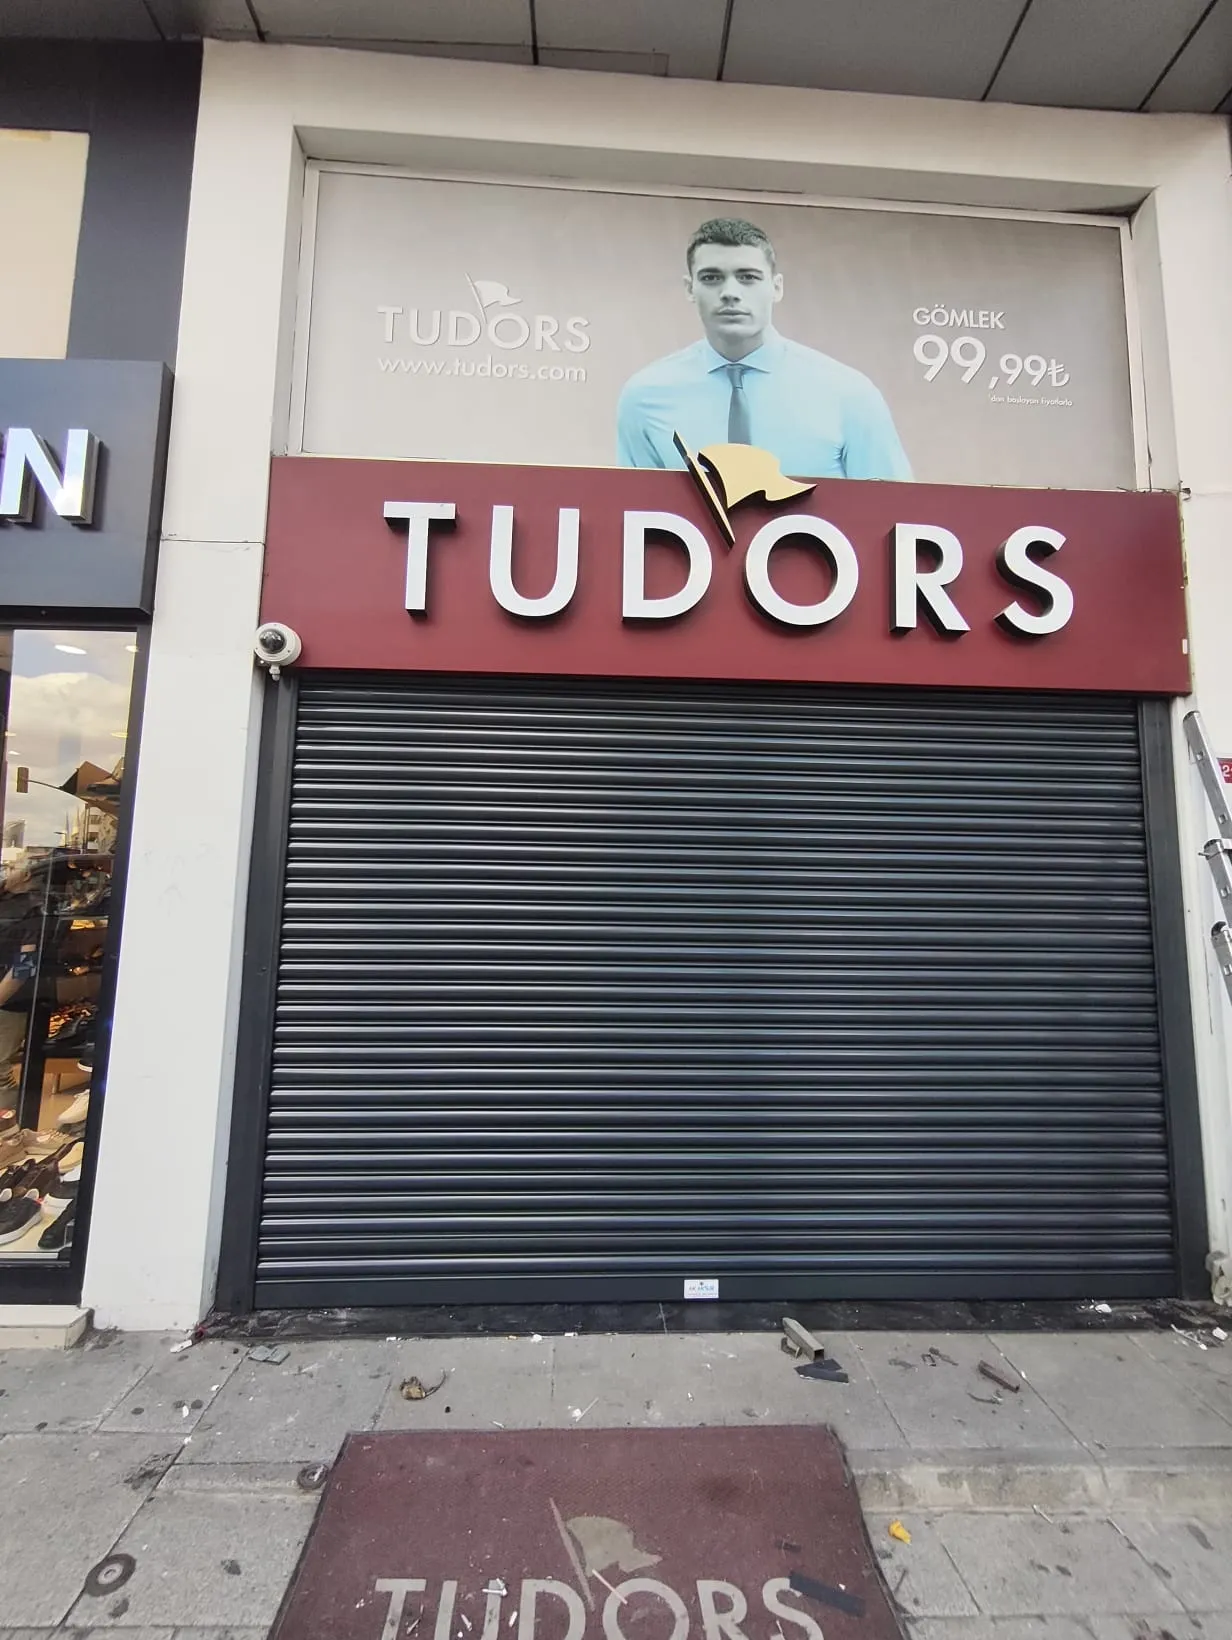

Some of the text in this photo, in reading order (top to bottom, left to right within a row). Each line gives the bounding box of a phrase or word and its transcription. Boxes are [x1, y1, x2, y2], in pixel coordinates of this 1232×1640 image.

[377, 305, 591, 353] TUDORS
[913, 304, 1005, 329] GÖMLEK
[377, 354, 588, 383] www.tudors.com
[383, 502, 1075, 636] TUDORS
[374, 1577, 826, 1640] TUDORS
